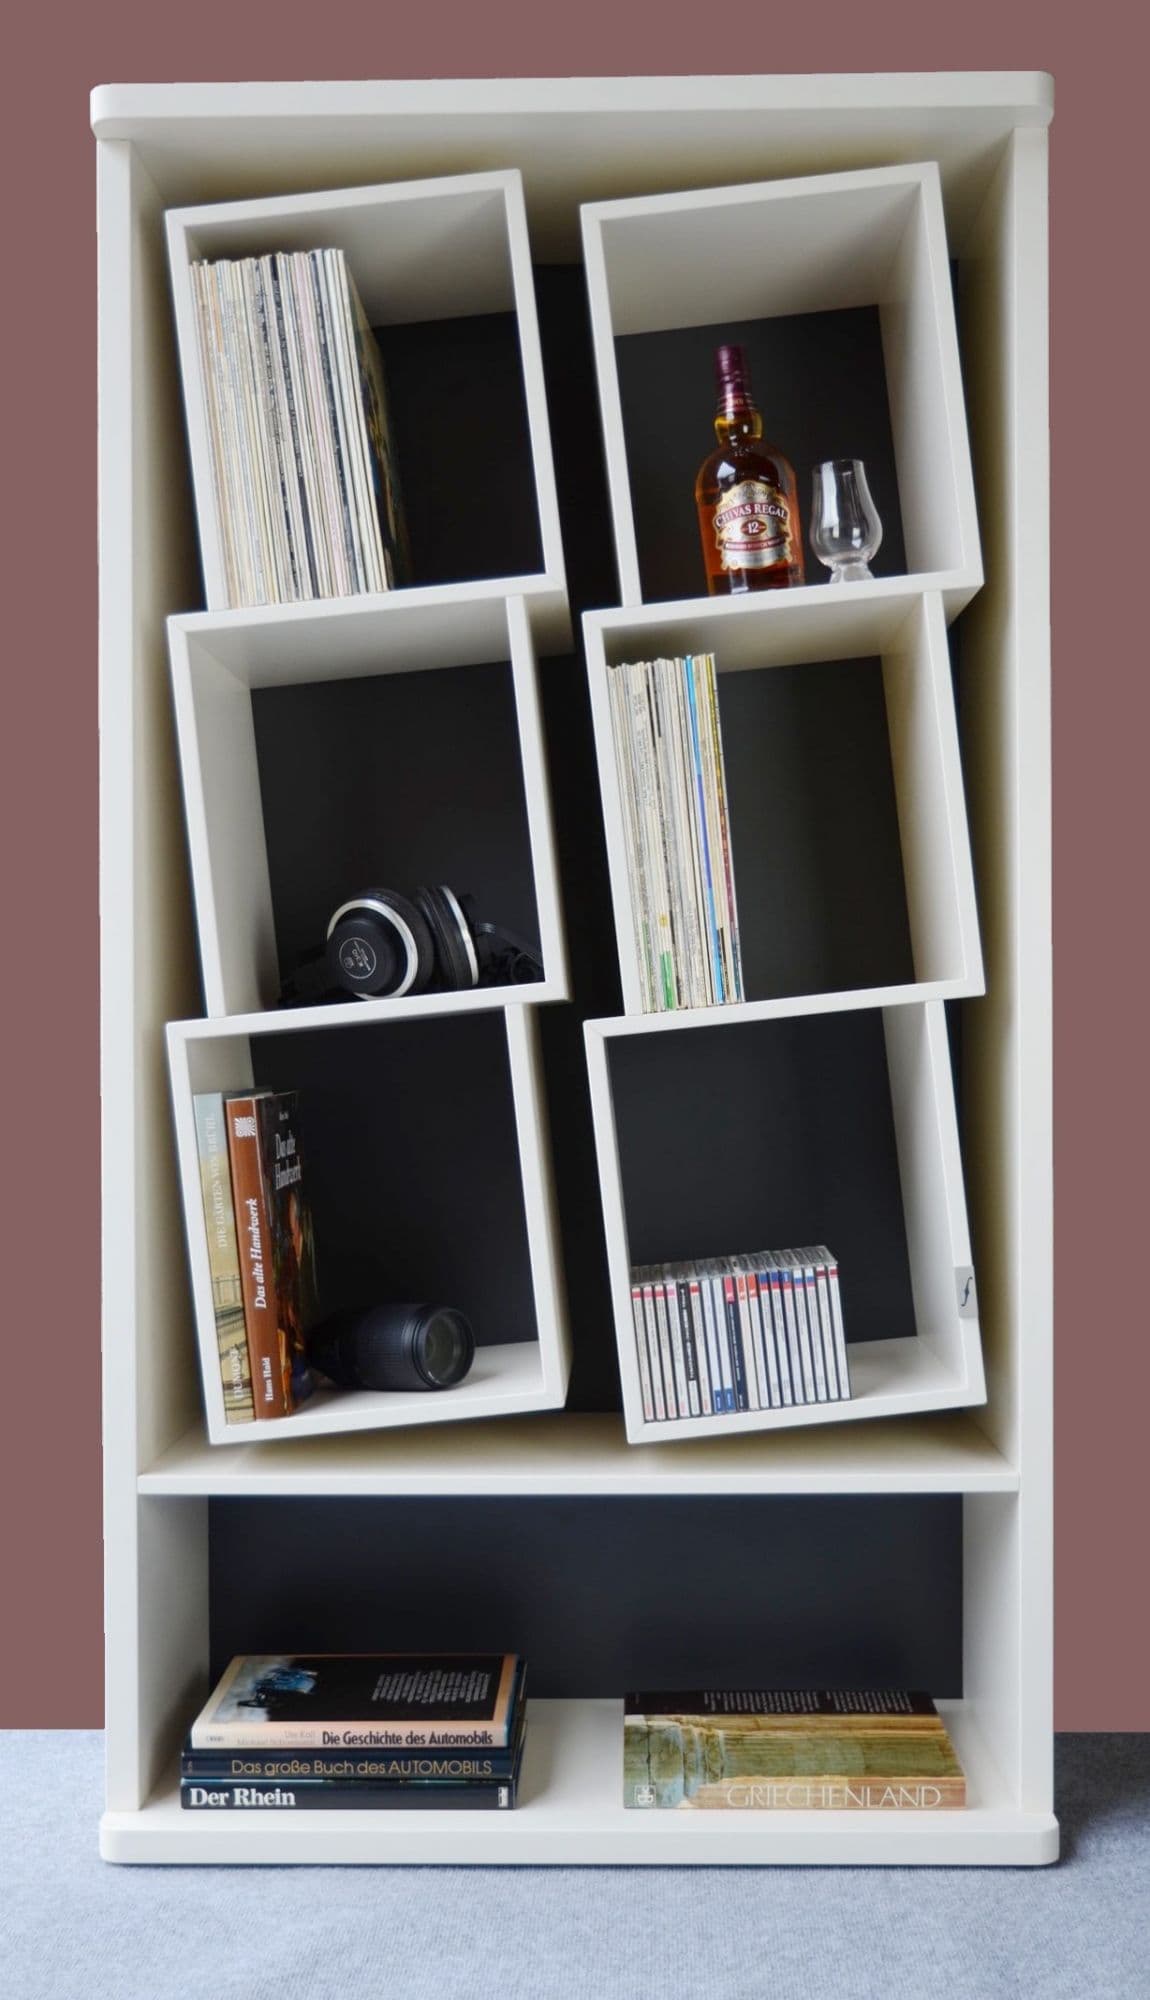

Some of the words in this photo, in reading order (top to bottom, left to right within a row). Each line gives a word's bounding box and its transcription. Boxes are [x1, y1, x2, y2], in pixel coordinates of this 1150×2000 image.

[715, 504, 752, 528] CHIVAS
[754, 503, 787, 519] REGAL
[747, 521, 759, 534] 12
[216, 1227, 229, 1248] DIE
[245, 1199, 262, 1260] Handwerk
[252, 1262, 265, 1283] alte
[255, 1286, 266, 1308] Das
[322, 1731, 340, 1745] Die
[342, 1731, 402, 1745] Geschichte
[405, 1731, 425, 1745] des
[428, 1731, 493, 1745] Automobils
[231, 1760, 262, 1774] Das
[264, 1760, 311, 1776] große
[313, 1760, 354, 1774] Buch
[356, 1760, 386, 1775] des
[388, 1760, 493, 1775] AUTOMOBILS
[190, 1788, 229, 1806] Der
[233, 1788, 296, 1807] Rhein
[726, 1785, 942, 1808] GRIECHENLAND
